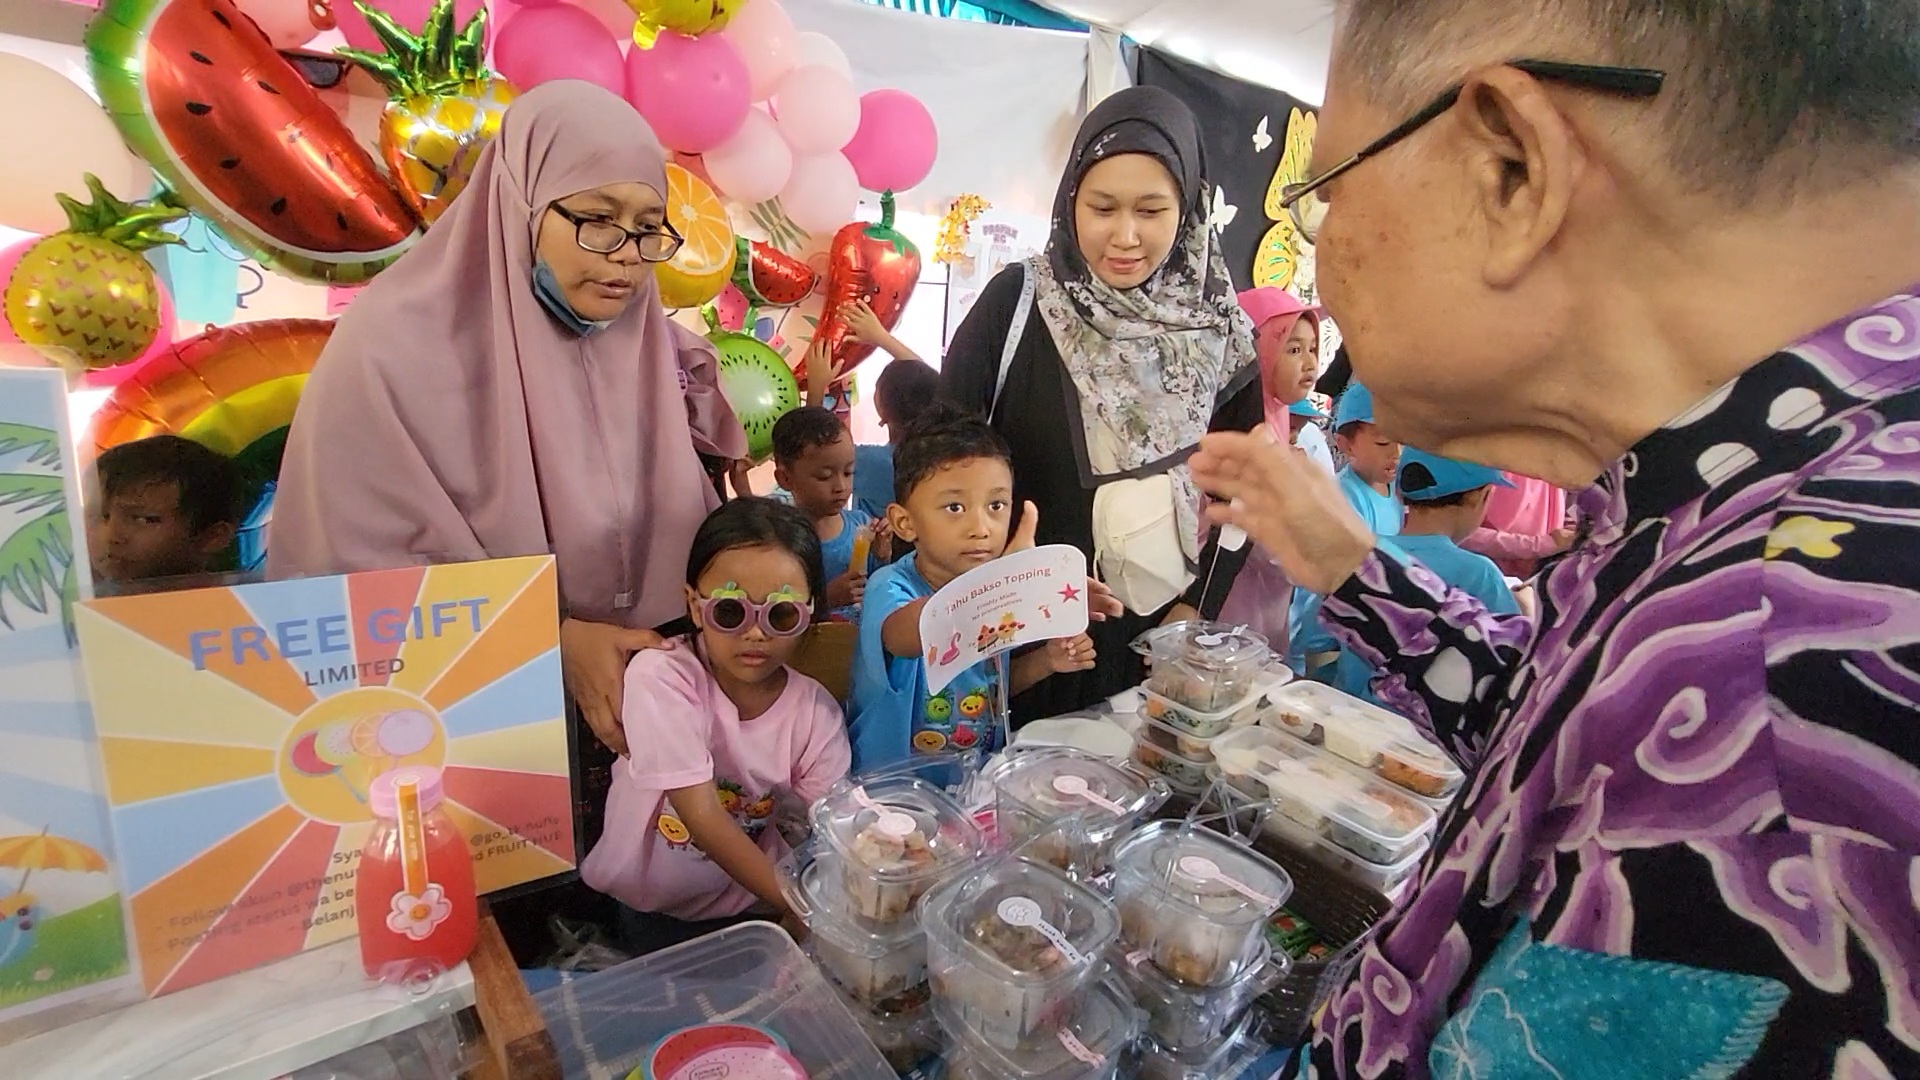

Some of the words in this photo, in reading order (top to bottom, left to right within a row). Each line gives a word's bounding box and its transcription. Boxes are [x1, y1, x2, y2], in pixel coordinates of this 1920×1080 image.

[944, 595, 968, 615] Tahu
[970, 581, 1001, 599] Bakso
[1004, 567, 1051, 584] Topping
[188, 614, 352, 671] FREE
[366, 597, 491, 643] GIFT
[304, 657, 406, 687] LIMITED
[332, 848, 364, 865] Sya
[487, 838, 528, 858] FRUIT
[302, 905, 356, 930] Belanj
